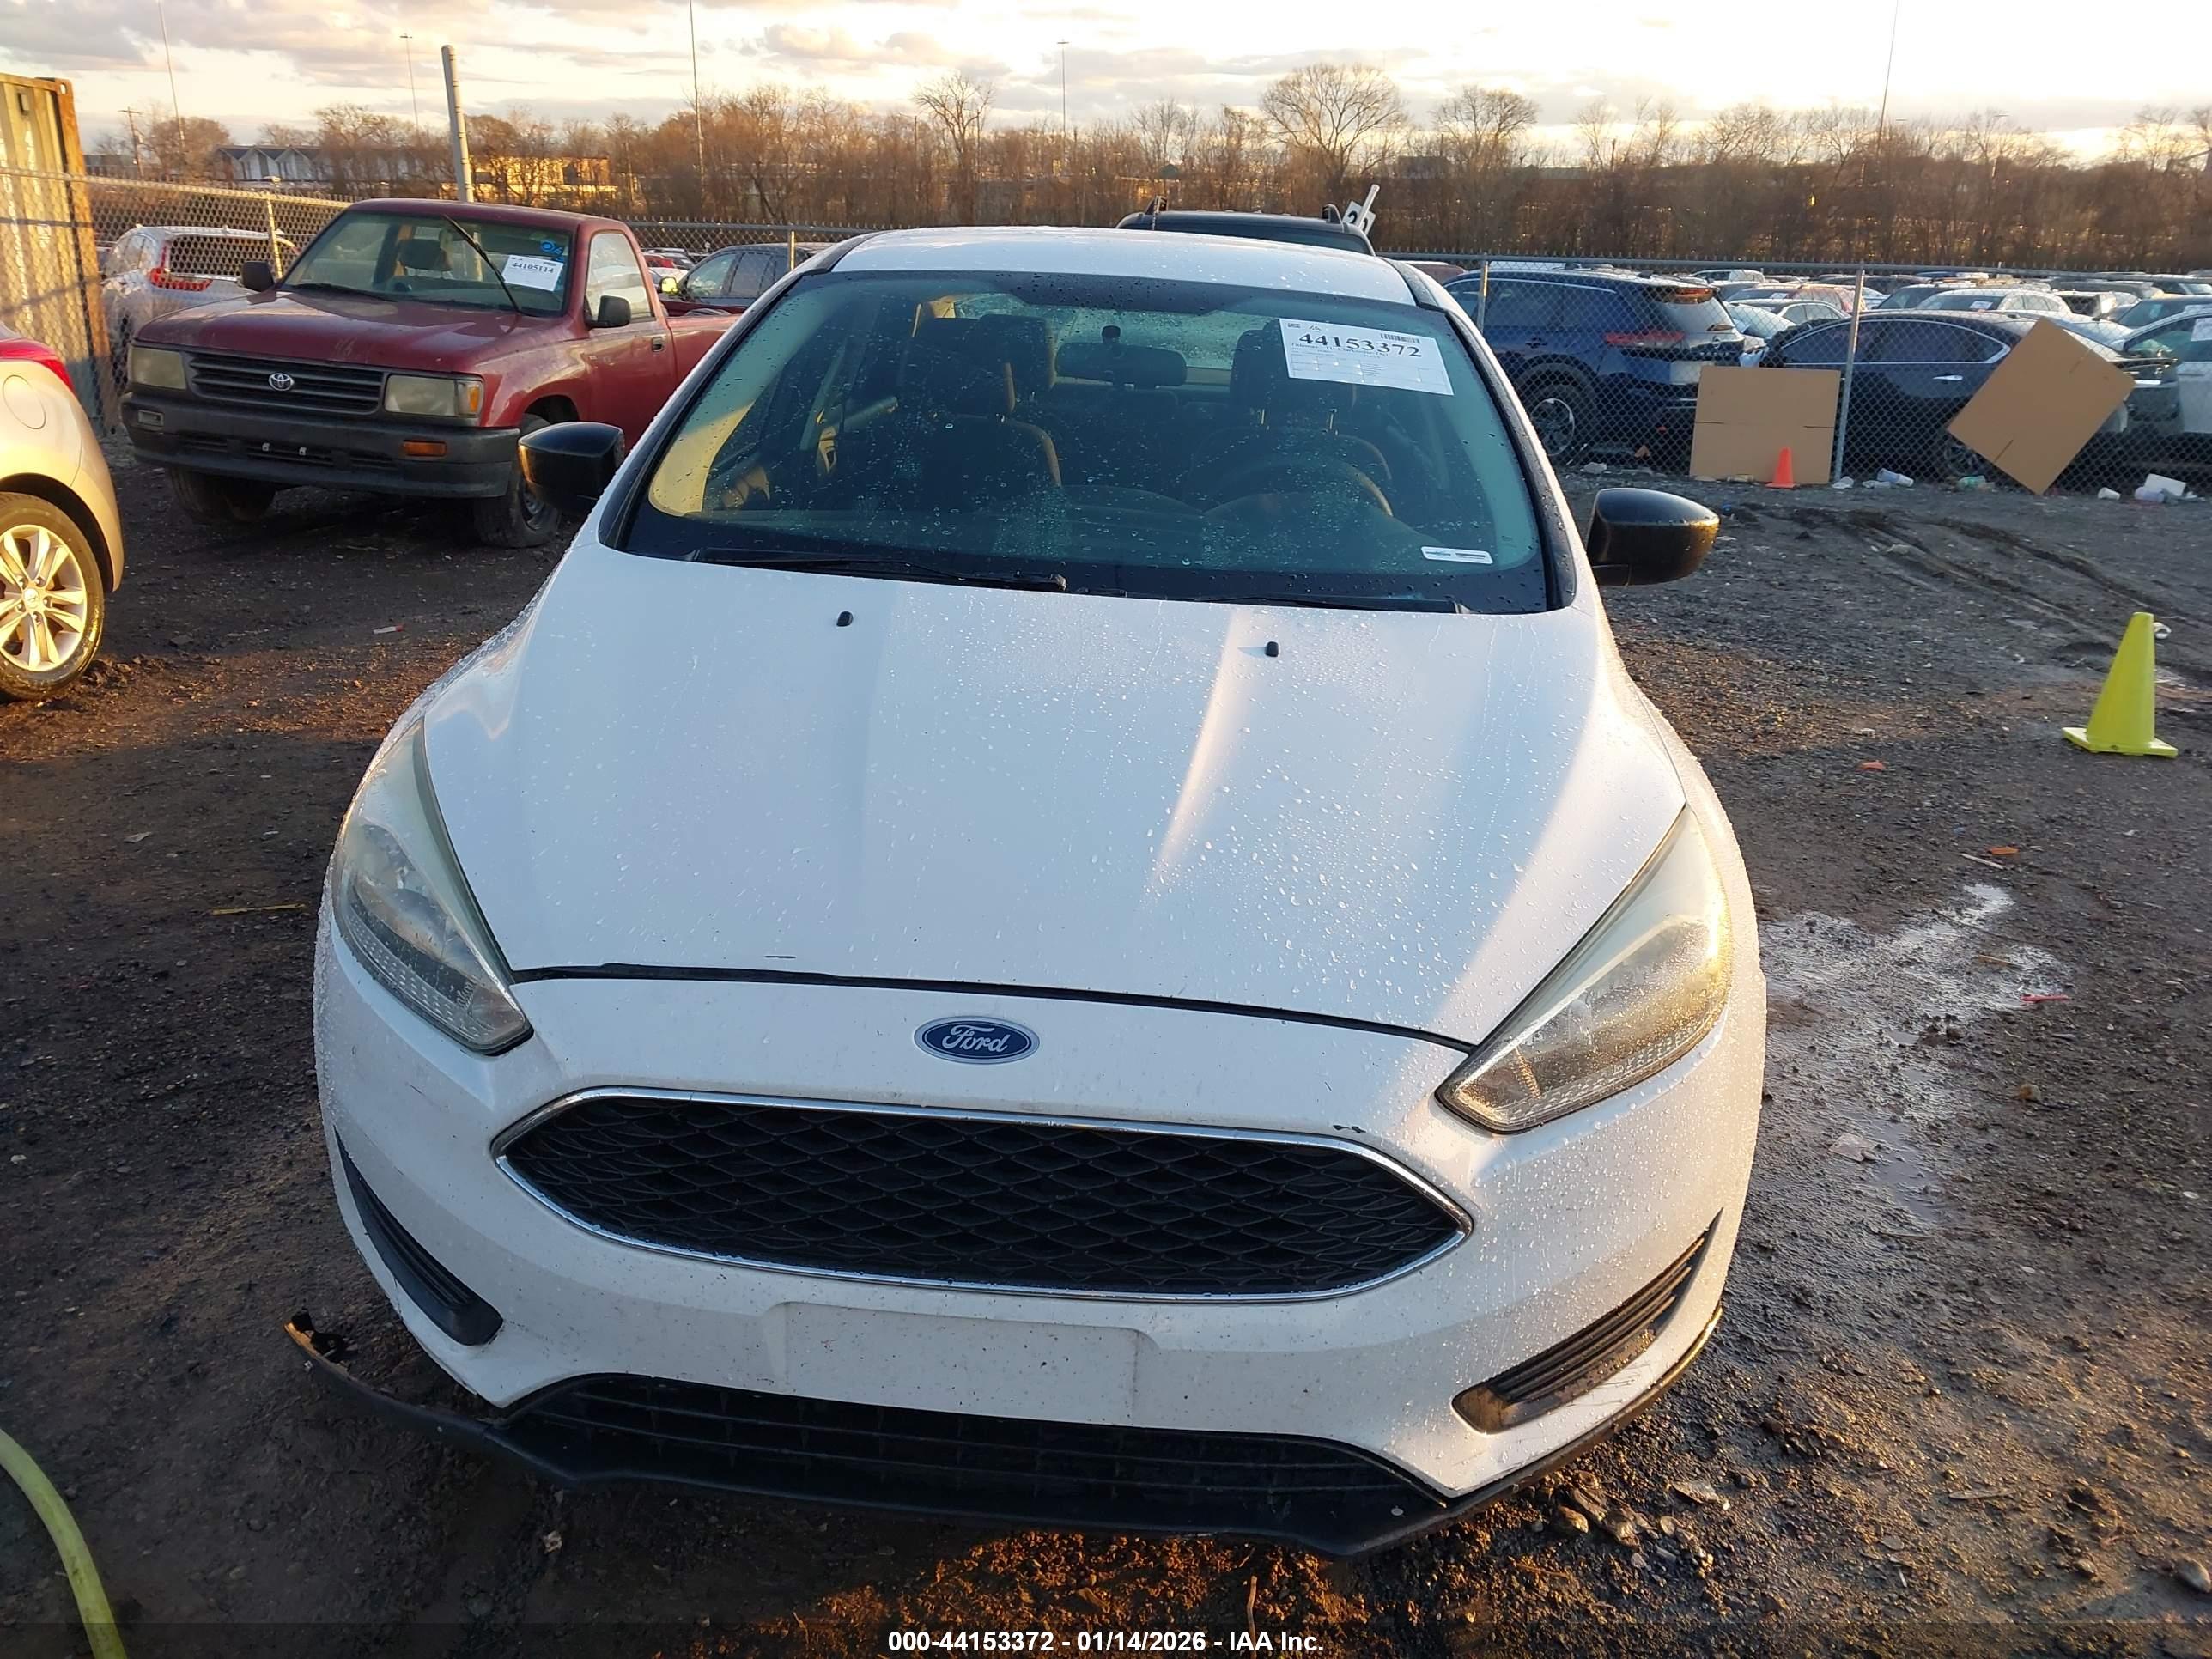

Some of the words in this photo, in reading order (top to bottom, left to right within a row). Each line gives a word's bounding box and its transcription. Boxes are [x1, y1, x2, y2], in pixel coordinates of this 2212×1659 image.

[511, 262, 555, 273] 44105114
[1298, 333, 1422, 357] 44153372
[941, 1024, 1011, 1053] Ford
